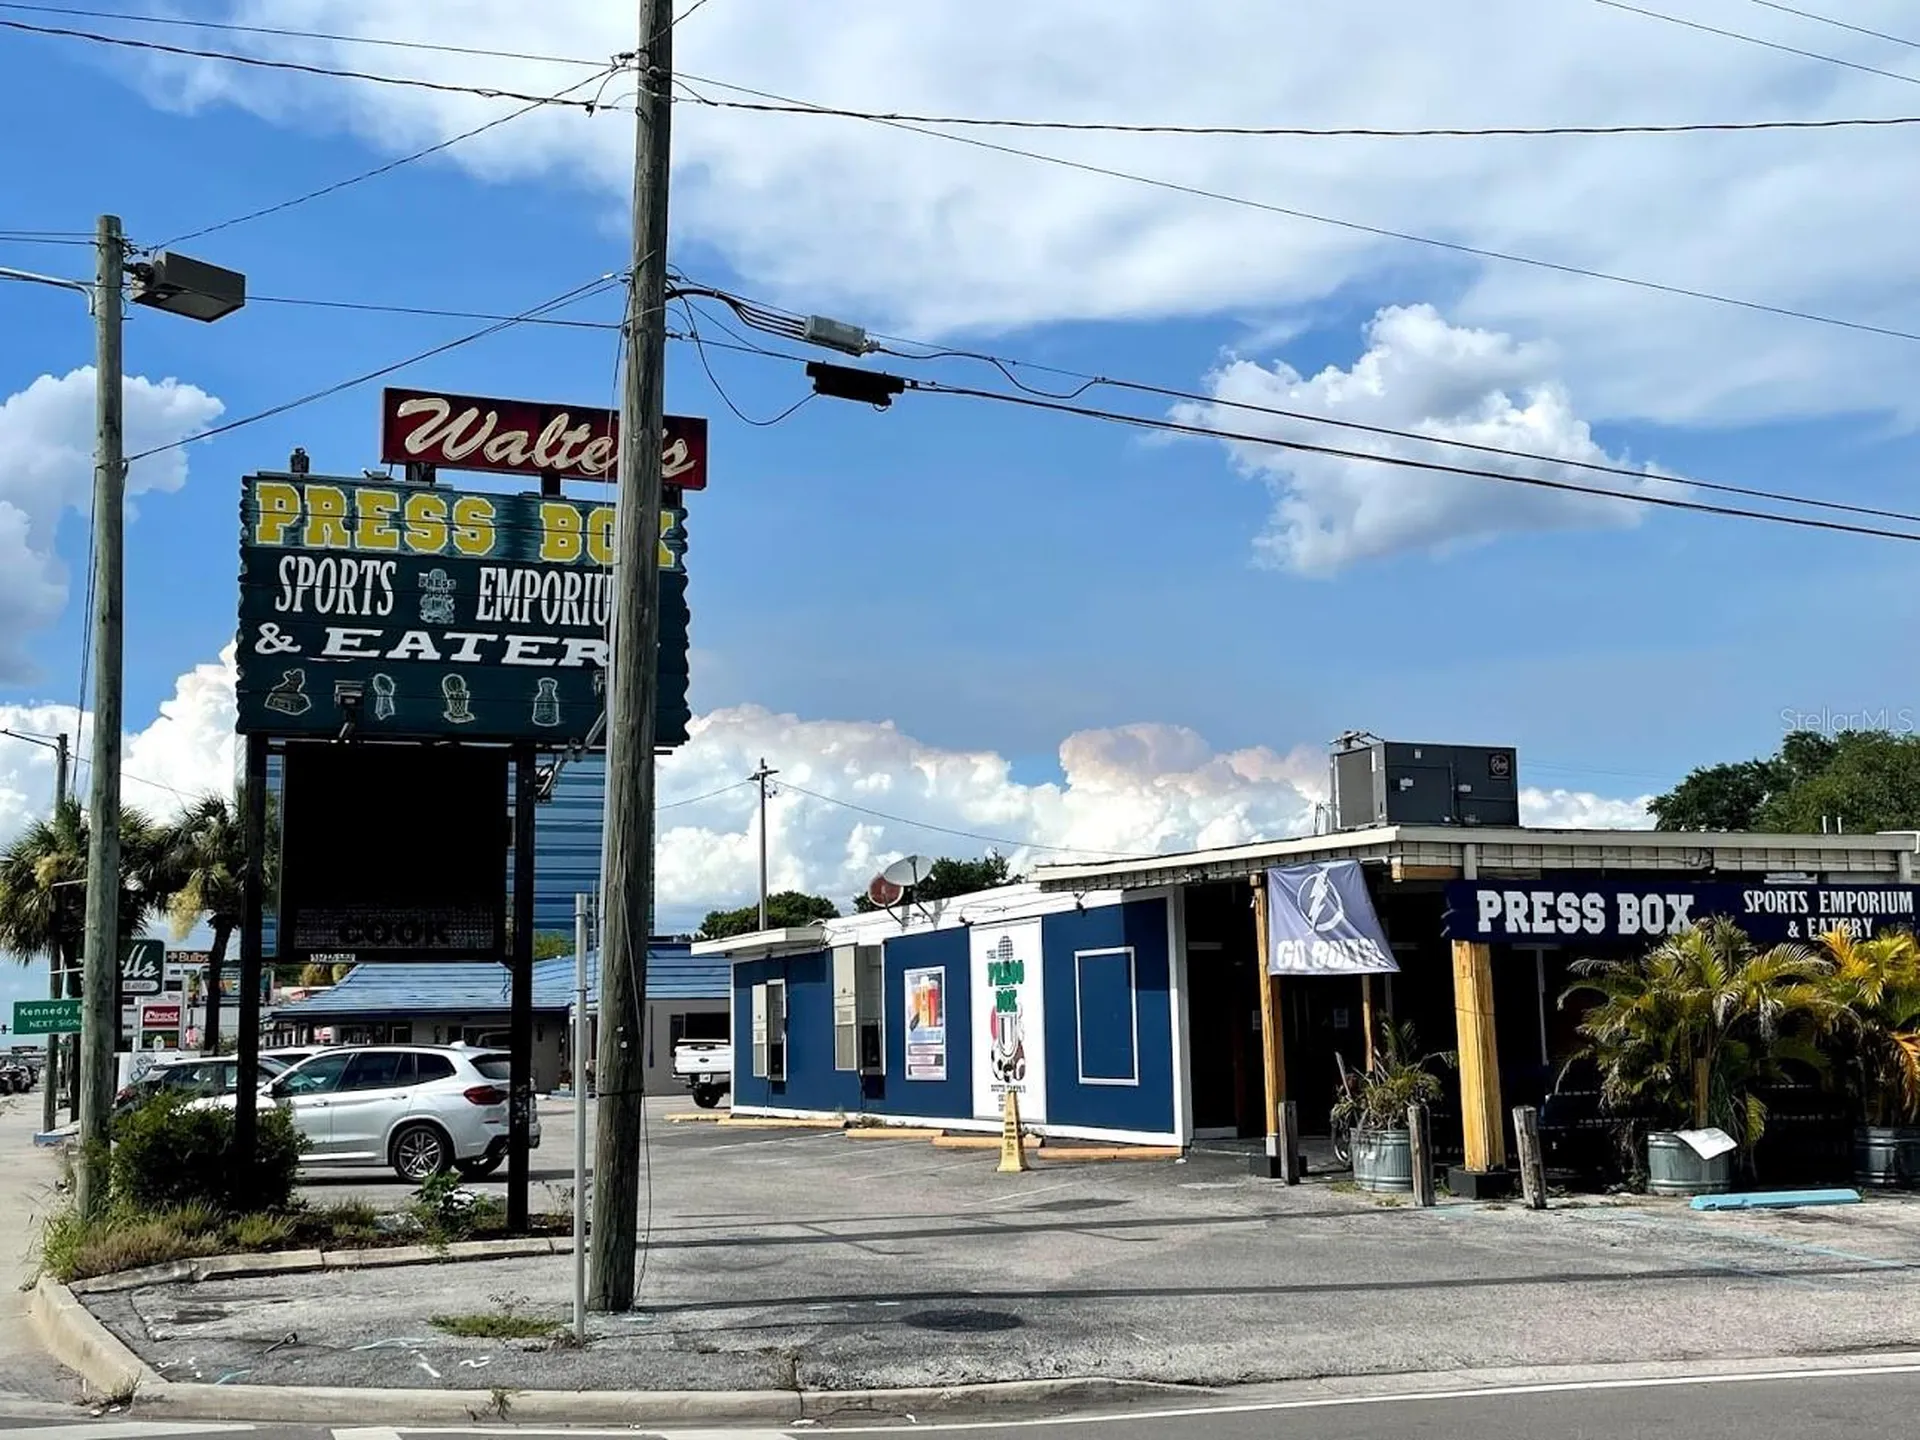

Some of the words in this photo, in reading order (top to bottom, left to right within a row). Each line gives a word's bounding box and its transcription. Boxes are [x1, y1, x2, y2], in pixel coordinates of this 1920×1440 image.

[397, 396, 697, 478] Walte's
[256, 482, 497, 557] PRESS
[274, 555, 398, 617] SPORTS
[475, 566, 616, 627] EMPORIU
[254, 622, 301, 655] &
[320, 626, 610, 667] EATER
[1476, 889, 1606, 935] PRESS
[1616, 892, 1695, 935] BOX
[1743, 890, 1809, 913] SPORTS
[1818, 891, 1913, 914] EMPORIUM
[1787, 920, 1800, 938] &
[19, 1007, 71, 1016] Kennedy
